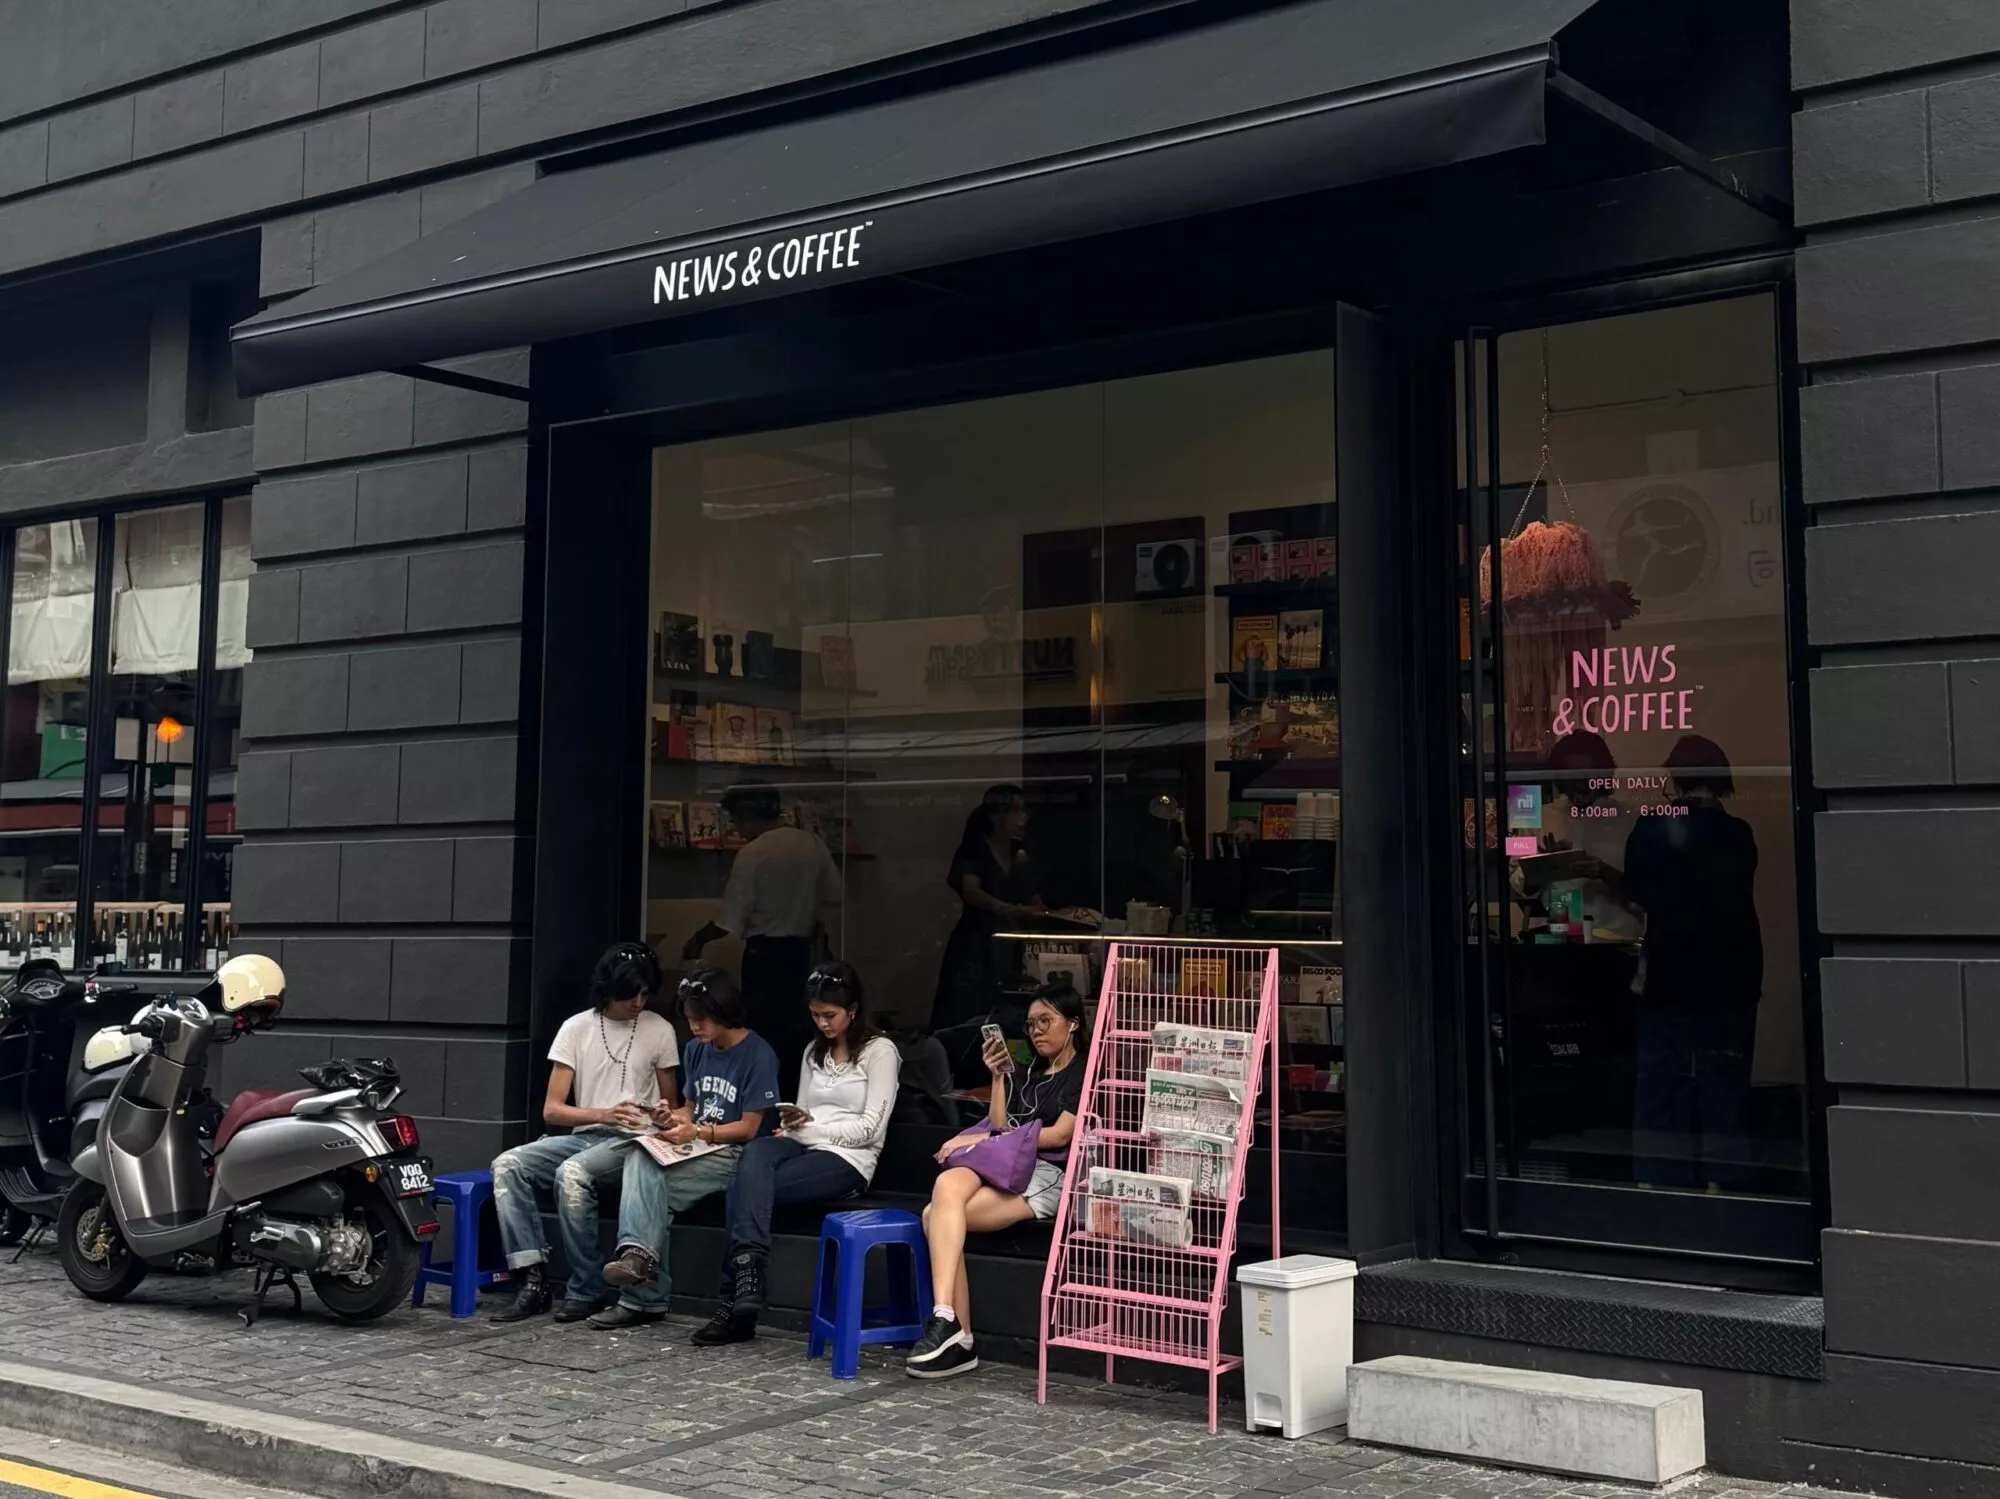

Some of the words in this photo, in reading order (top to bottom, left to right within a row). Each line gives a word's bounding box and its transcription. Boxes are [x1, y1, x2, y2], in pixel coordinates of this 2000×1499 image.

[653, 251, 738, 304] NEWS
[1572, 644, 1677, 689] NEWS
[1588, 778, 1620, 790] OPEN
[1627, 776, 1668, 789] DAILY
[1570, 805, 1617, 818] 8:00am
[1640, 804, 1689, 818] 6:00pm
[401, 1174, 430, 1191] 8412
